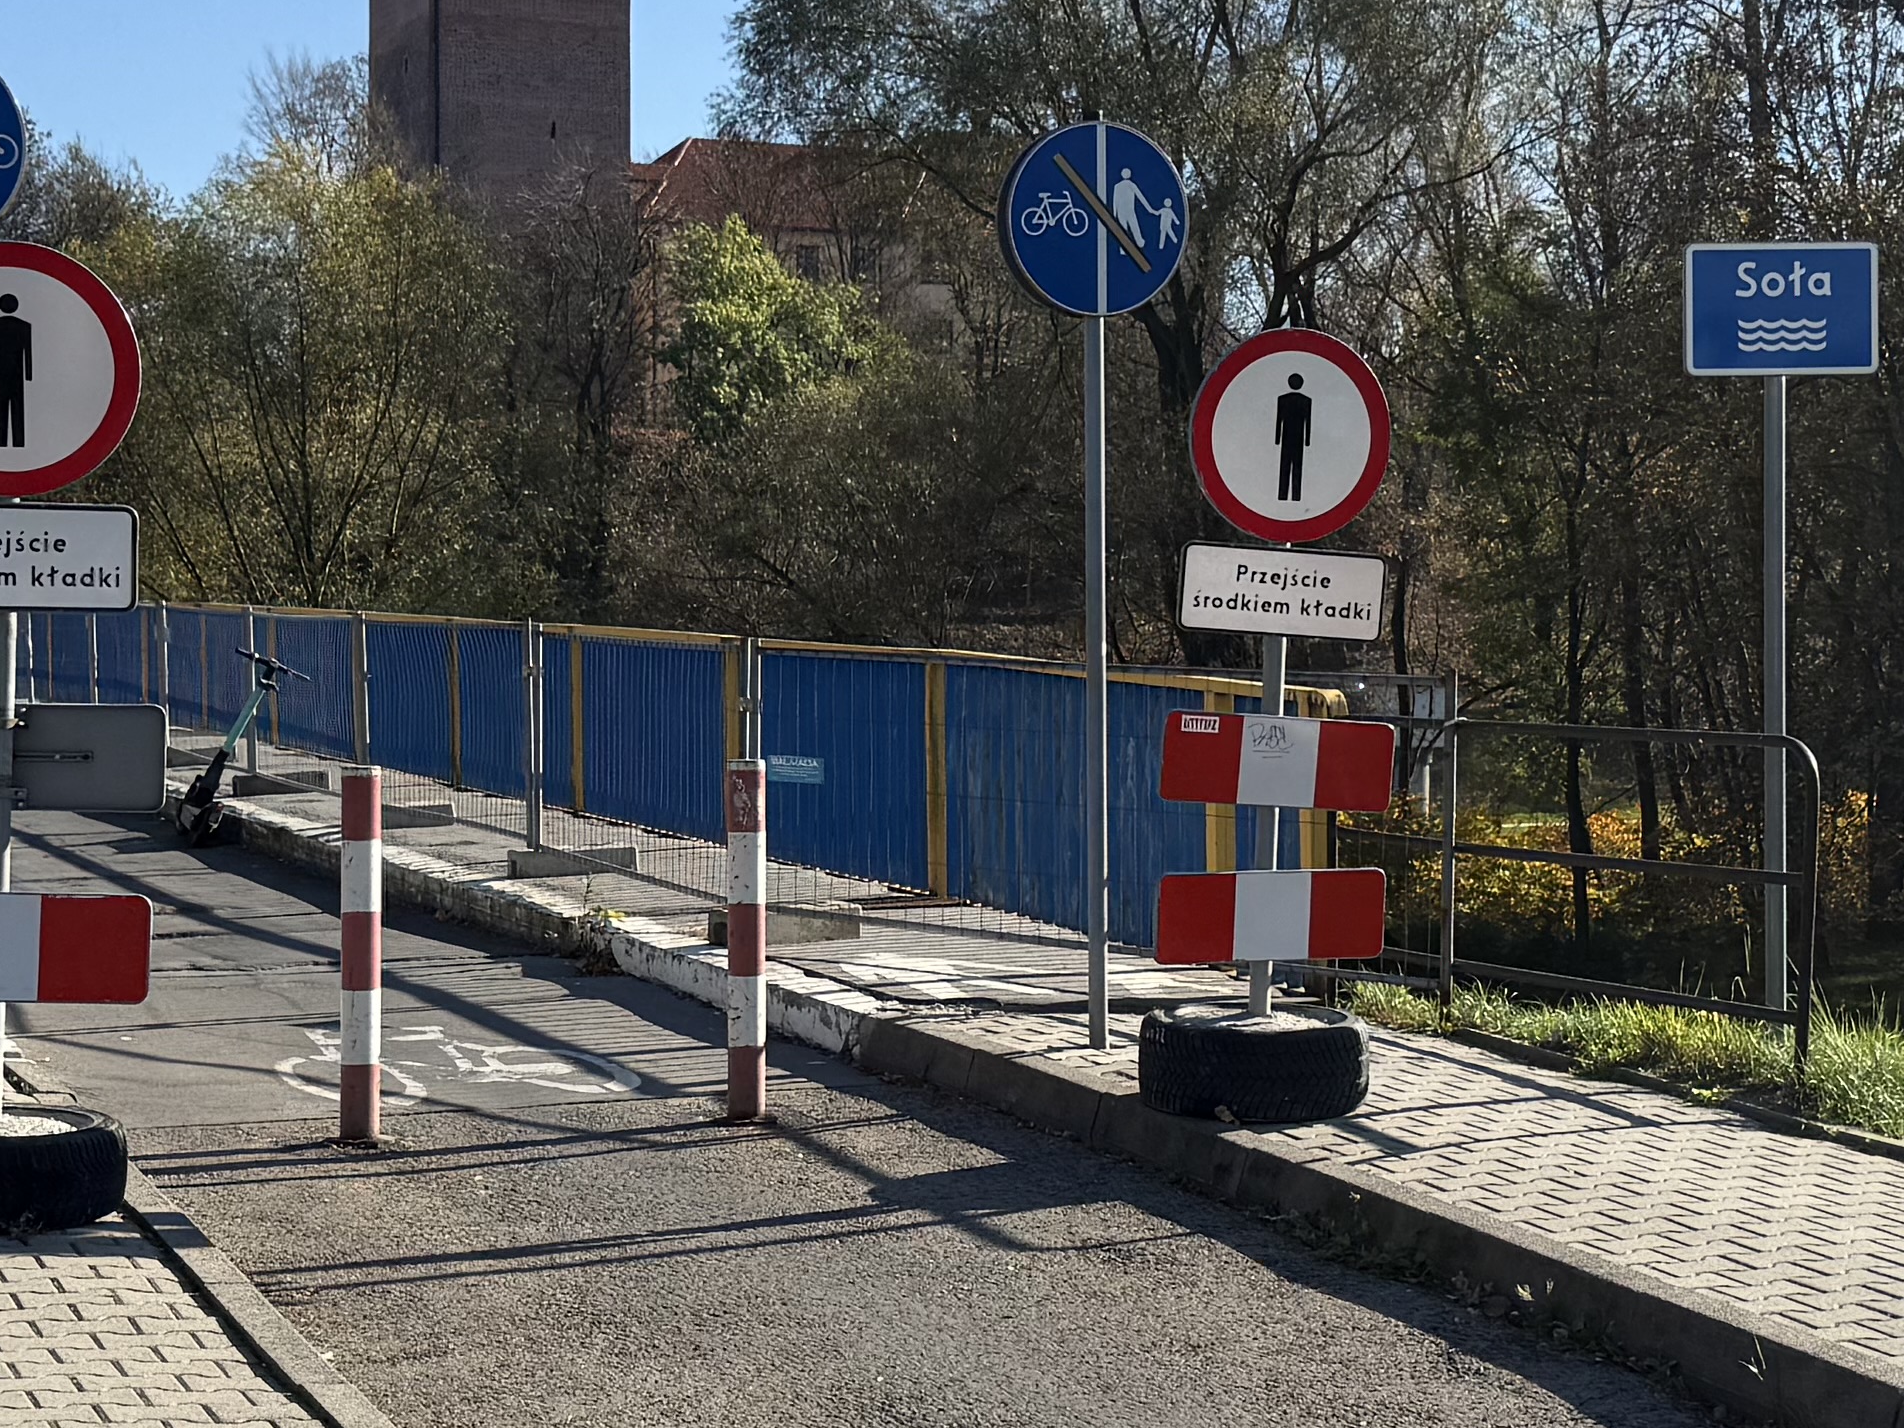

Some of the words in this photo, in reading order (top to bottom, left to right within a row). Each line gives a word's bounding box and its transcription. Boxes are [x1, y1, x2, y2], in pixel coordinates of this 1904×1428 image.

[1735, 260, 1832, 298] Soła
[31, 565, 120, 588] kładki
[1236, 563, 1332, 591] Przejście
[1192, 589, 1290, 615] środkiem
[1300, 598, 1372, 621] kładki
